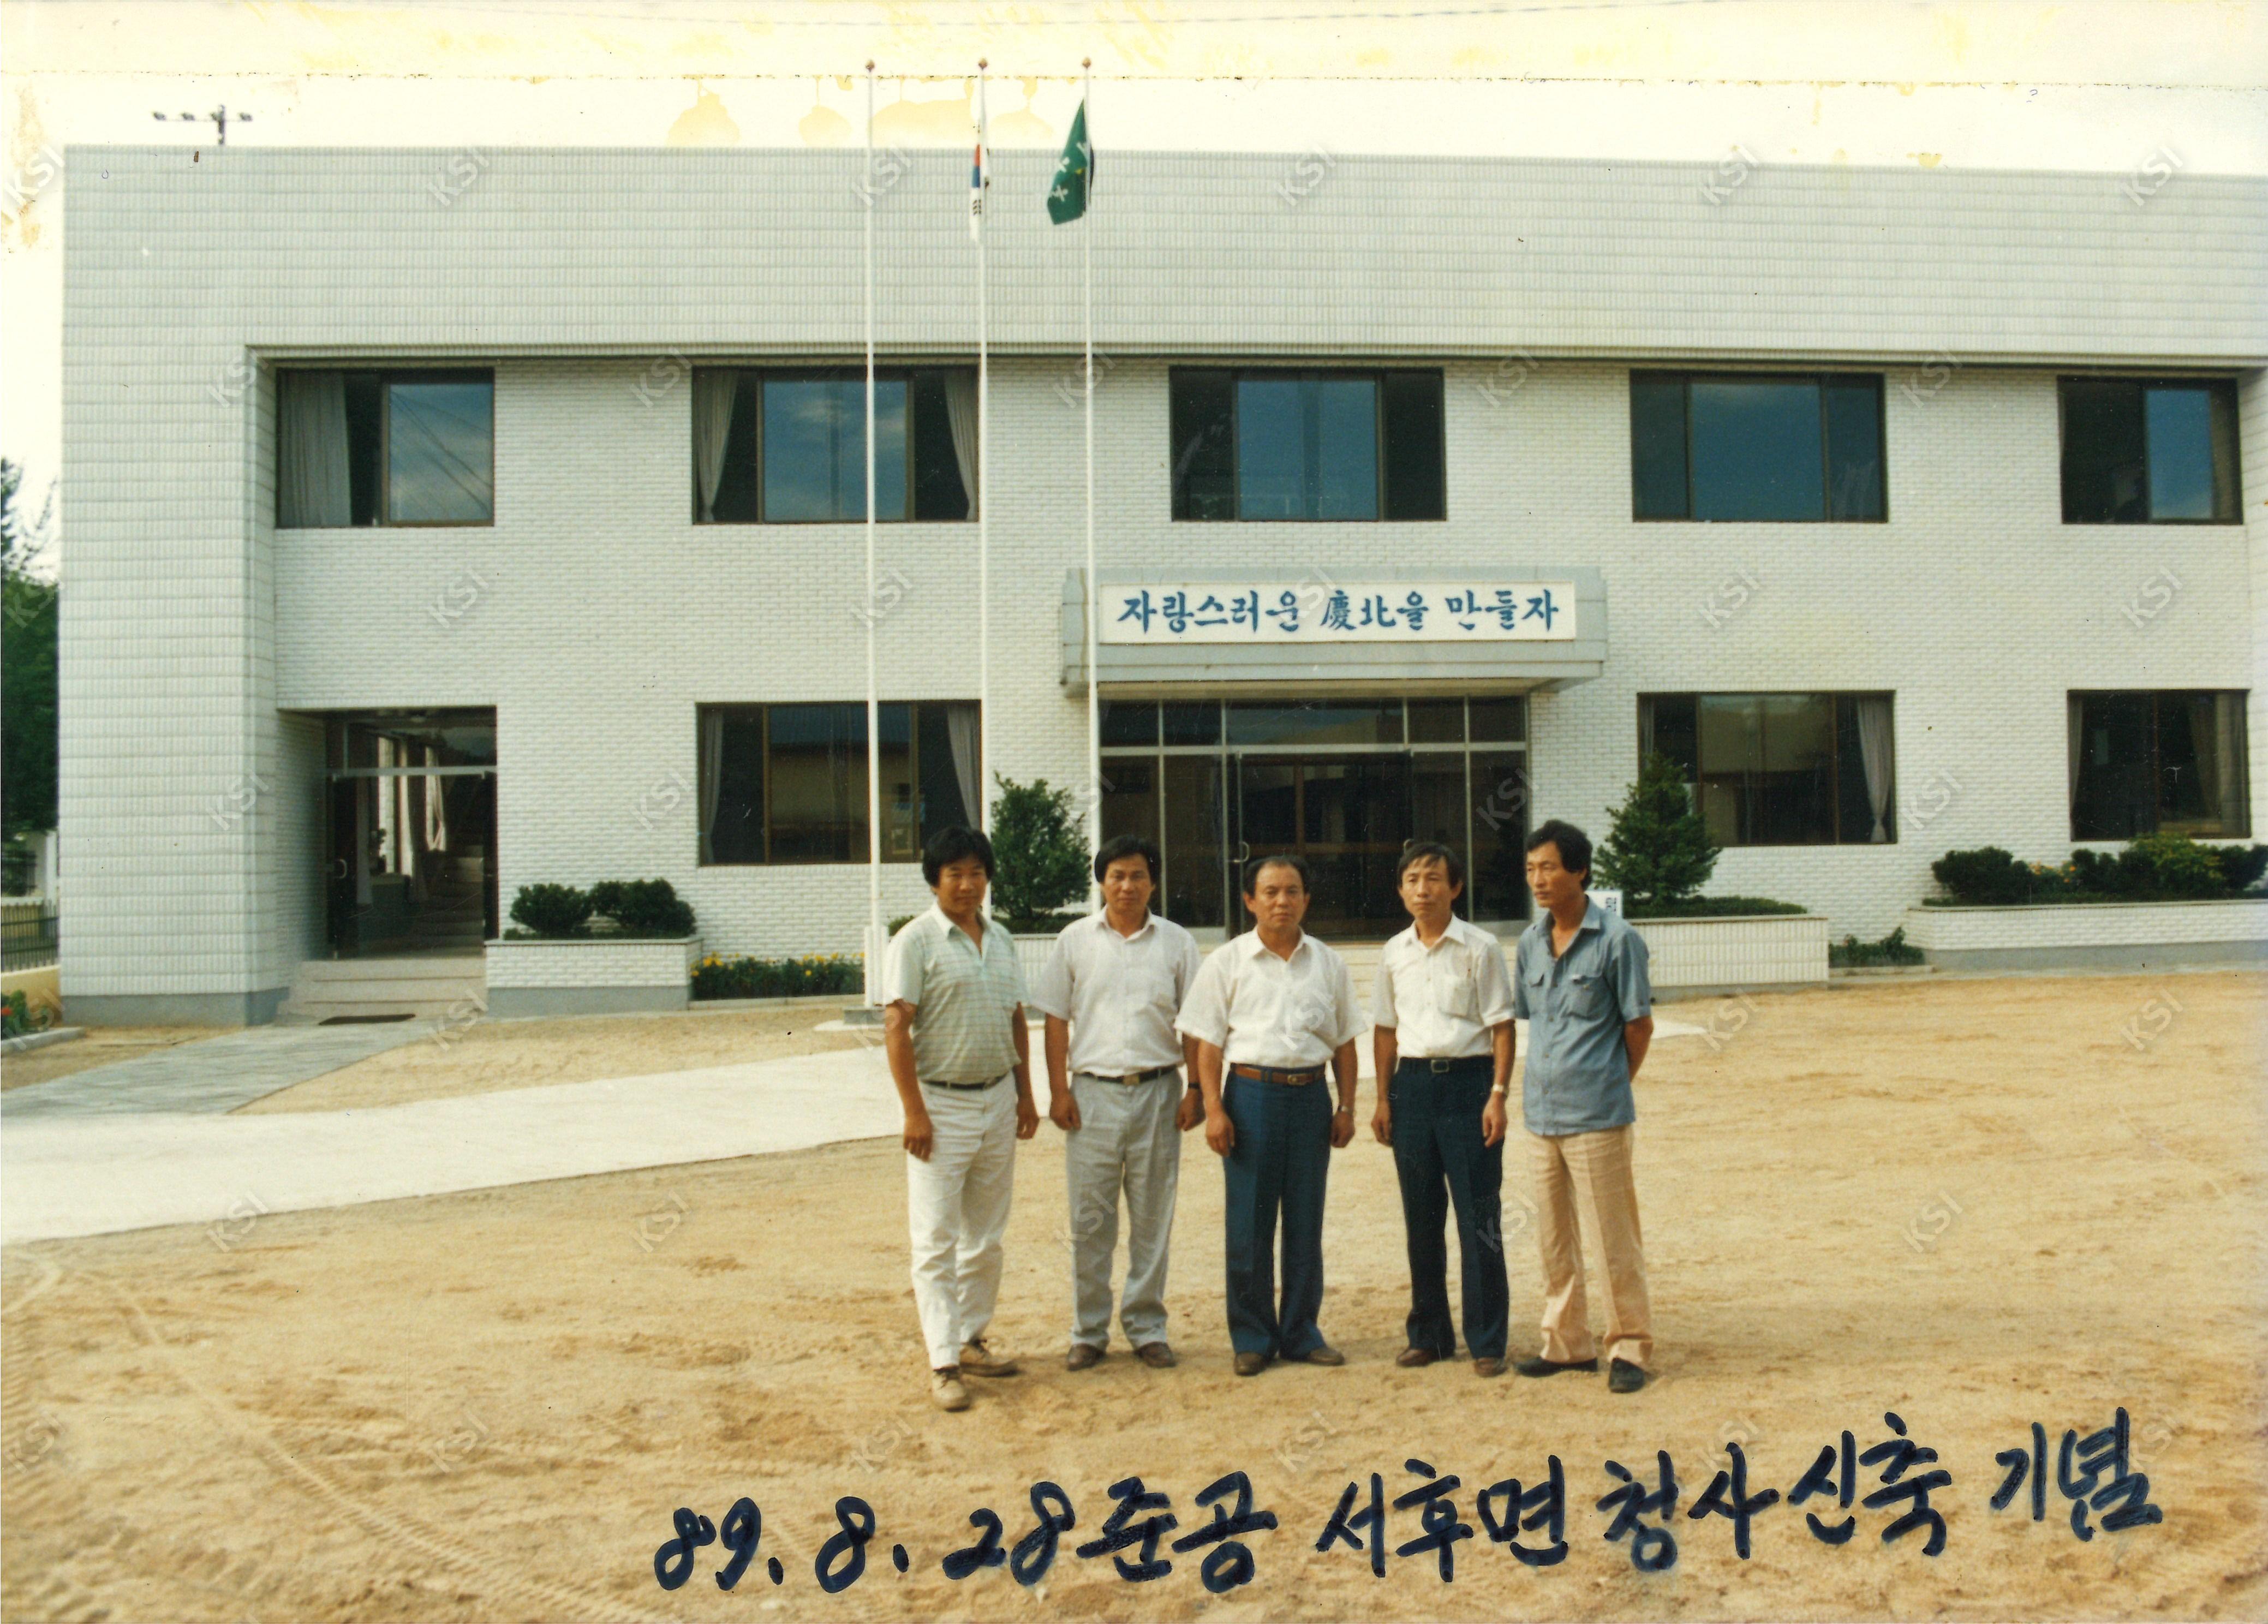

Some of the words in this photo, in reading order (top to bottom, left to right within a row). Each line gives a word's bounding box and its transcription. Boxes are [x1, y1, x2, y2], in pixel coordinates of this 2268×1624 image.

[1117, 589, 1299, 634] 자랑스러운
[1320, 589, 1430, 631] 慶北을
[1445, 588, 1560, 631] 만들자
